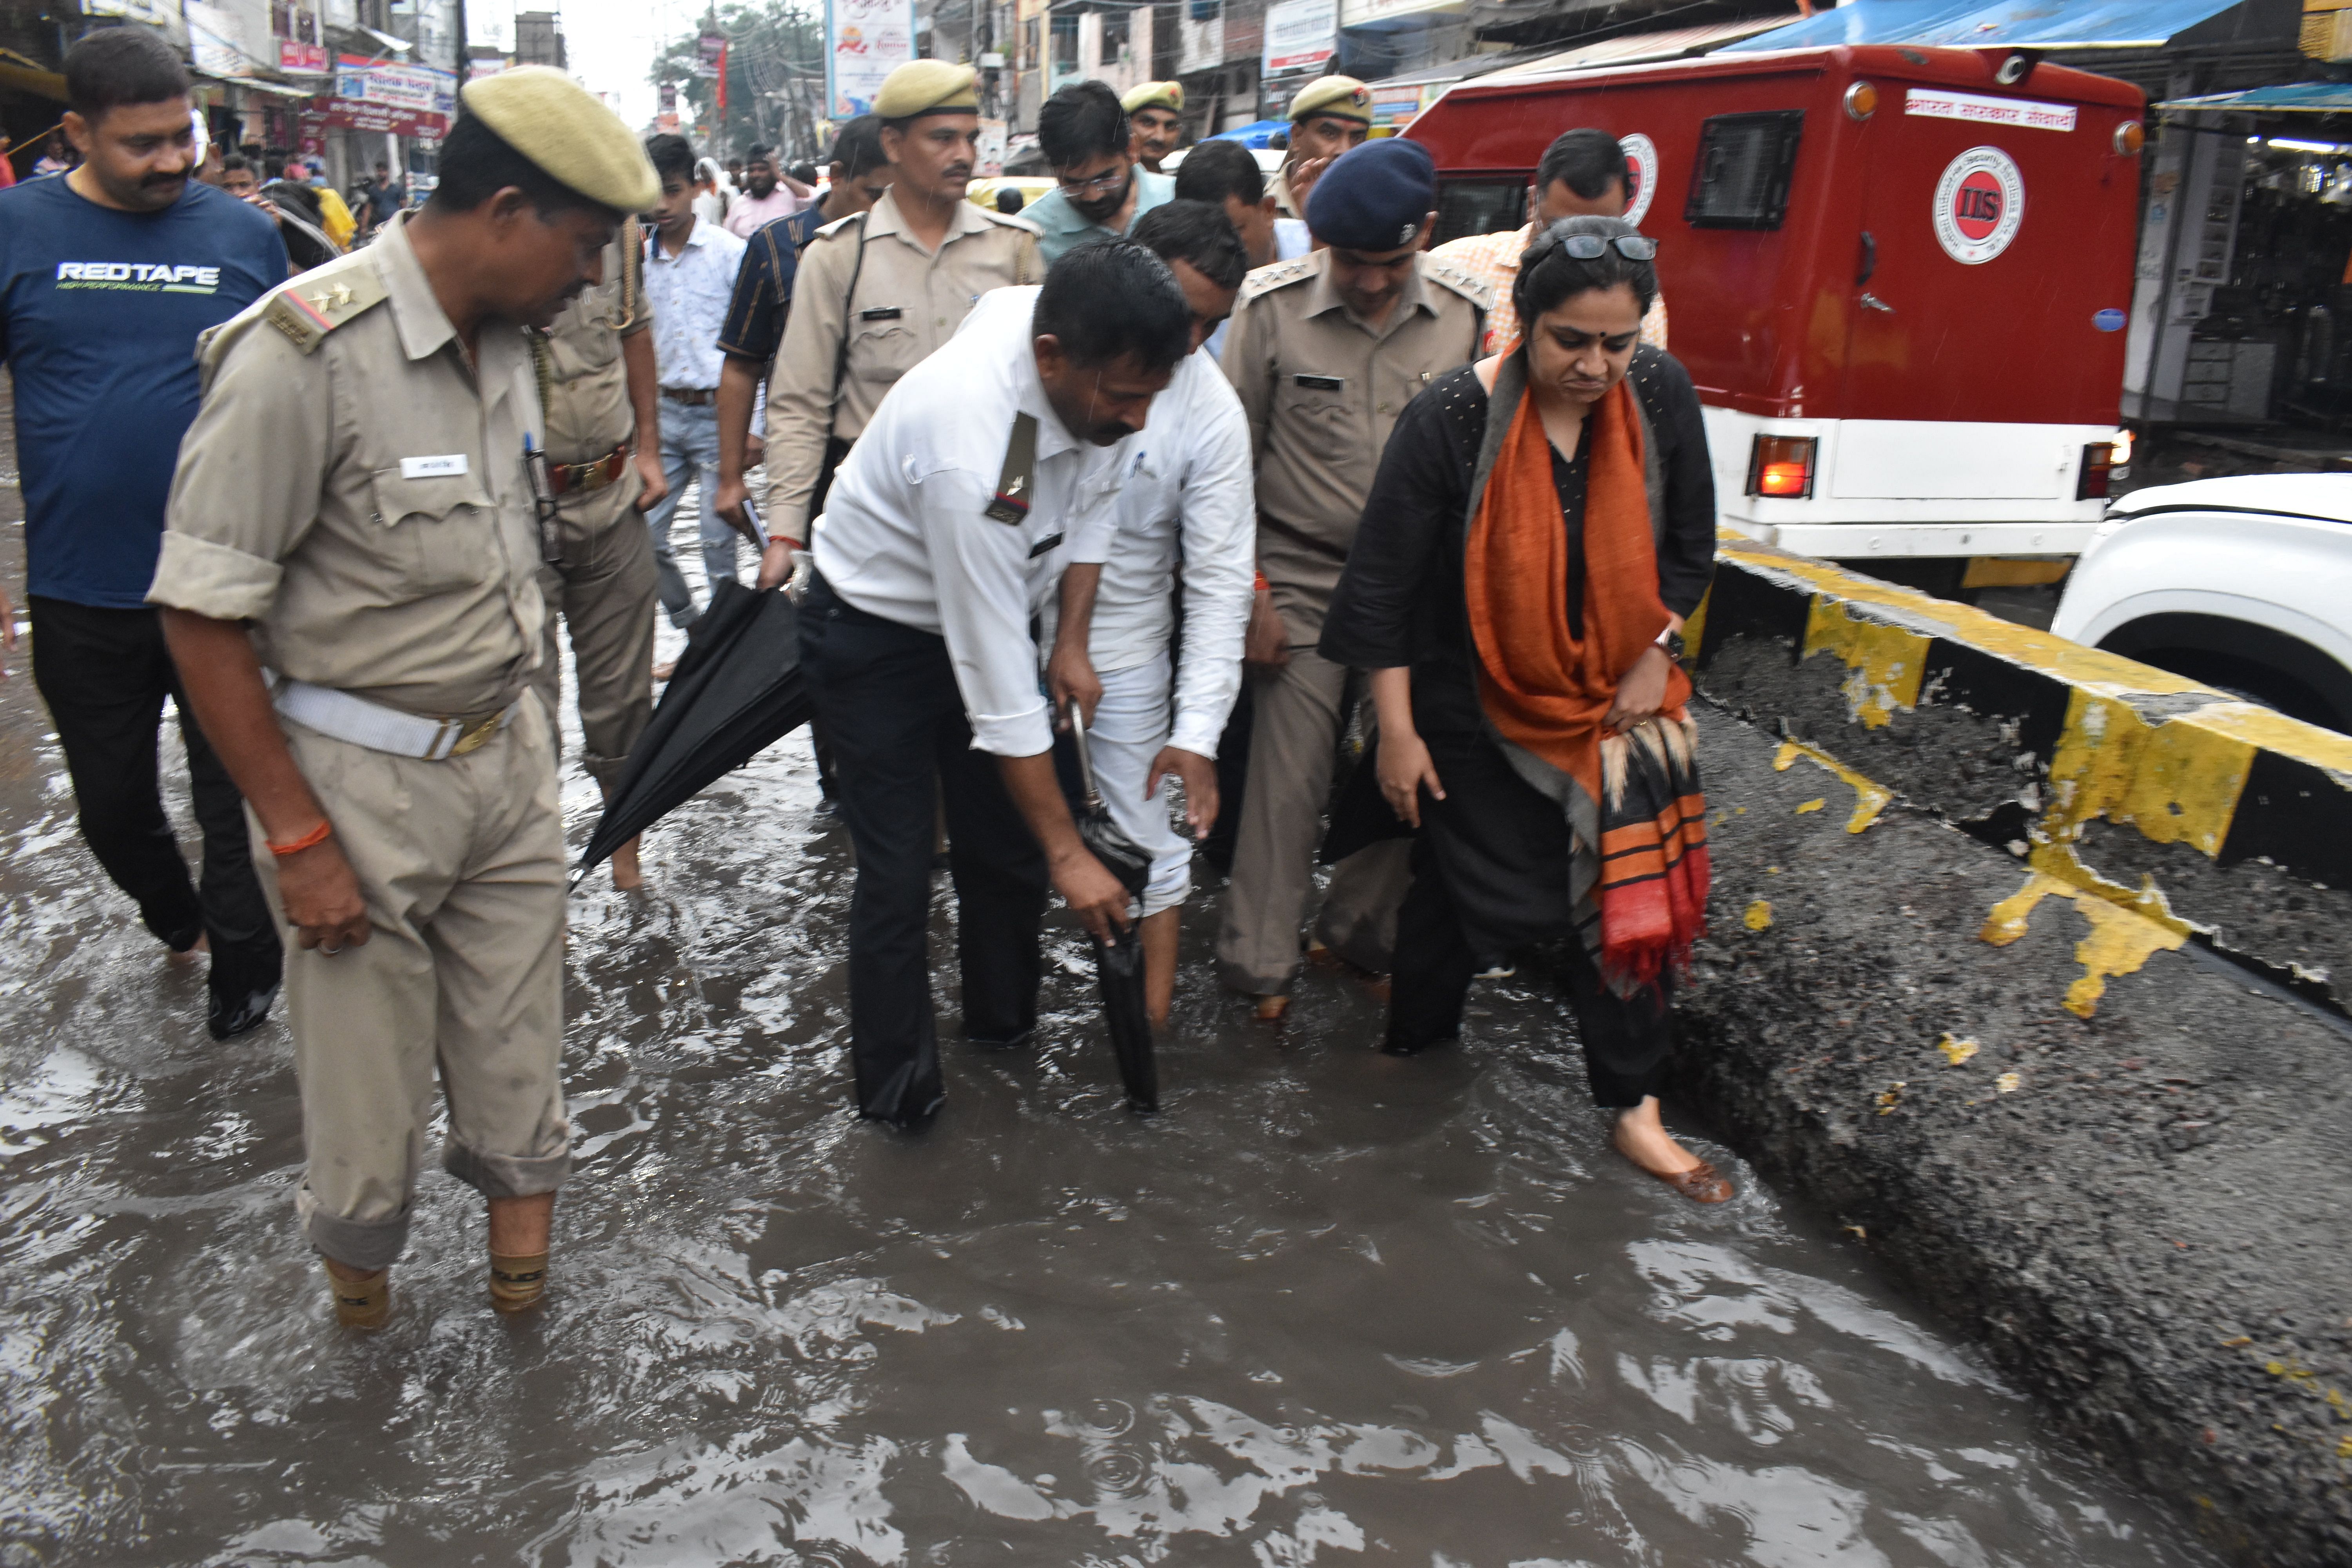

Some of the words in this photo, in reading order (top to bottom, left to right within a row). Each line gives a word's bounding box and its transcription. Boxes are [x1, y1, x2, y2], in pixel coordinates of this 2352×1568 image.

[1960, 103, 2020, 122] सरकार
[1958, 186, 2001, 222] IIS
[57, 262, 221, 285] REDTAPE
